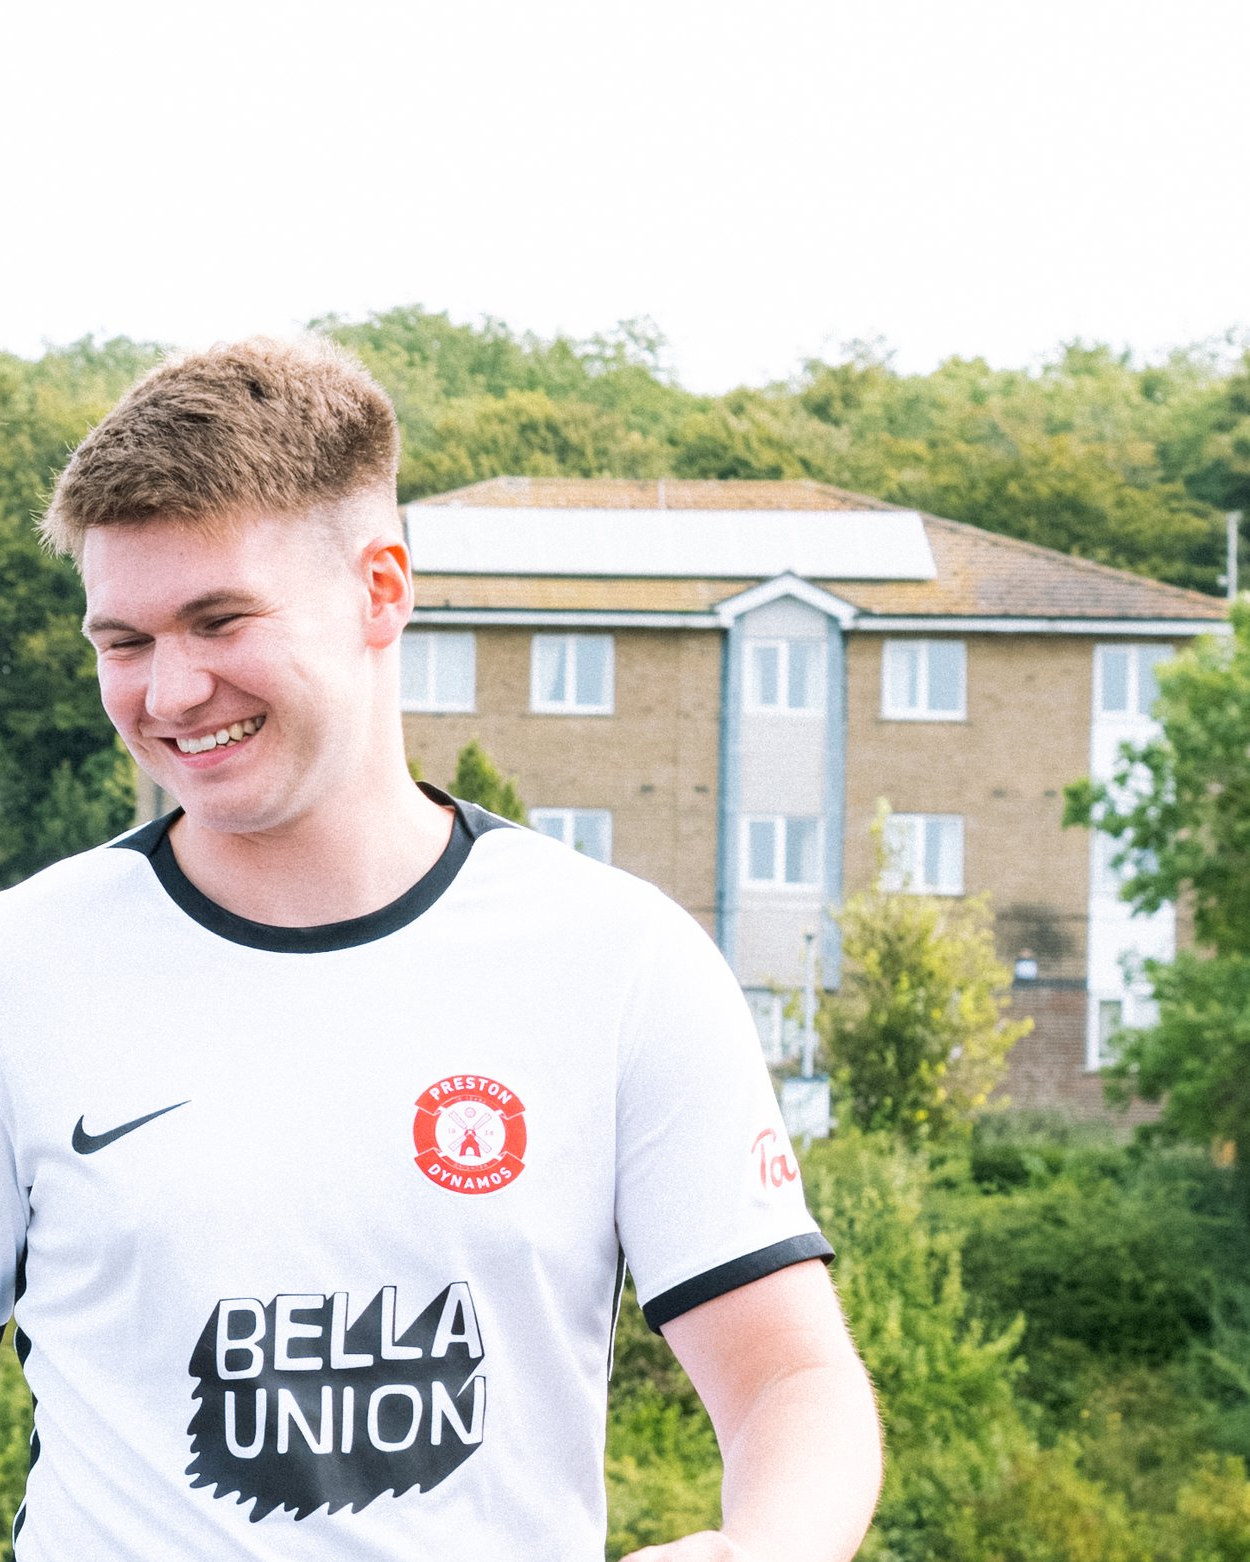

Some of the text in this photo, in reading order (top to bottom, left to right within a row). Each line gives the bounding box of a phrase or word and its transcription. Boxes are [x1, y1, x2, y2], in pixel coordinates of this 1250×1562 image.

[429, 1077, 512, 1104] PRESTON
[428, 1163, 512, 1189] DYNAMOS
[215, 1281, 485, 1380] BELLA
[224, 1376, 486, 1459] UNION
